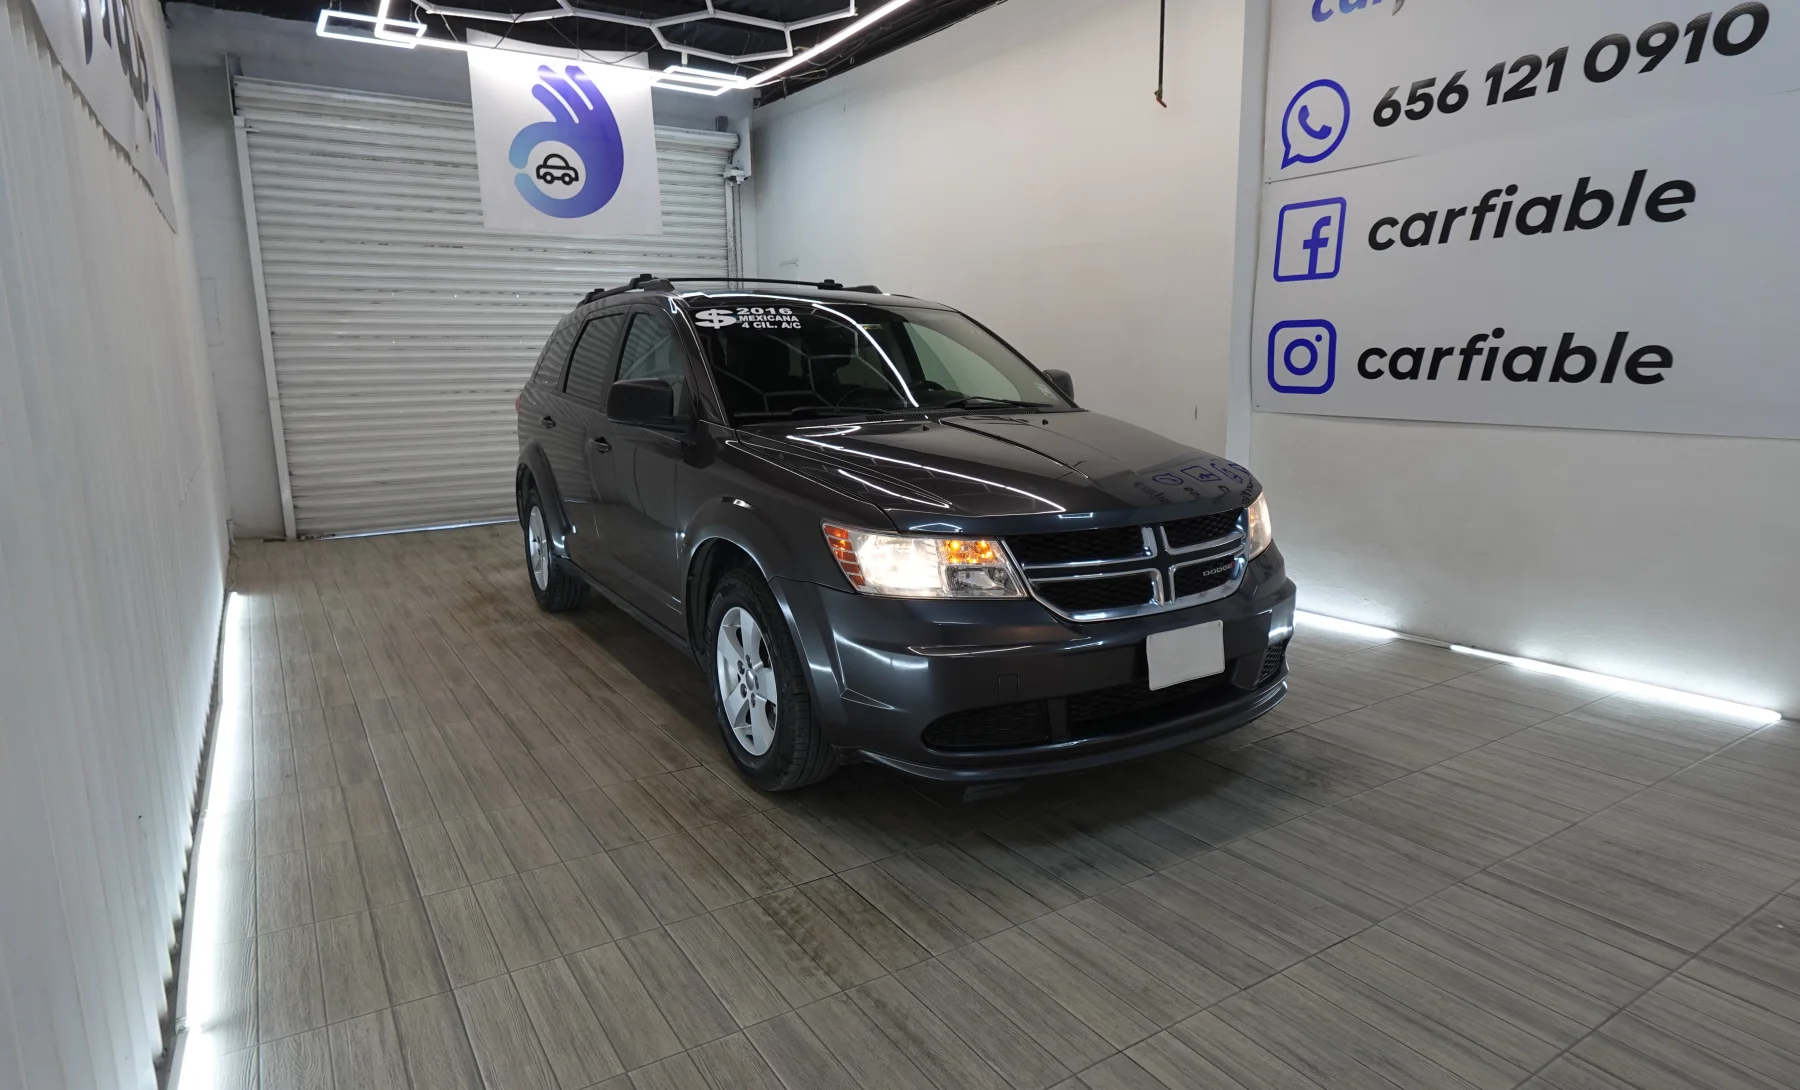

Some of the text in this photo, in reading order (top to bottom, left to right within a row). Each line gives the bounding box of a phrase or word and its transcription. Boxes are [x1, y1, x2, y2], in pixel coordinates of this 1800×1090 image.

[1372, 1, 1770, 128] 656 121 0910
[1368, 168, 1697, 252] carfiable
[736, 307, 793, 315] 2016
[741, 321, 802, 329] 4 CIL. A/C
[1357, 327, 1675, 386] carfiable
